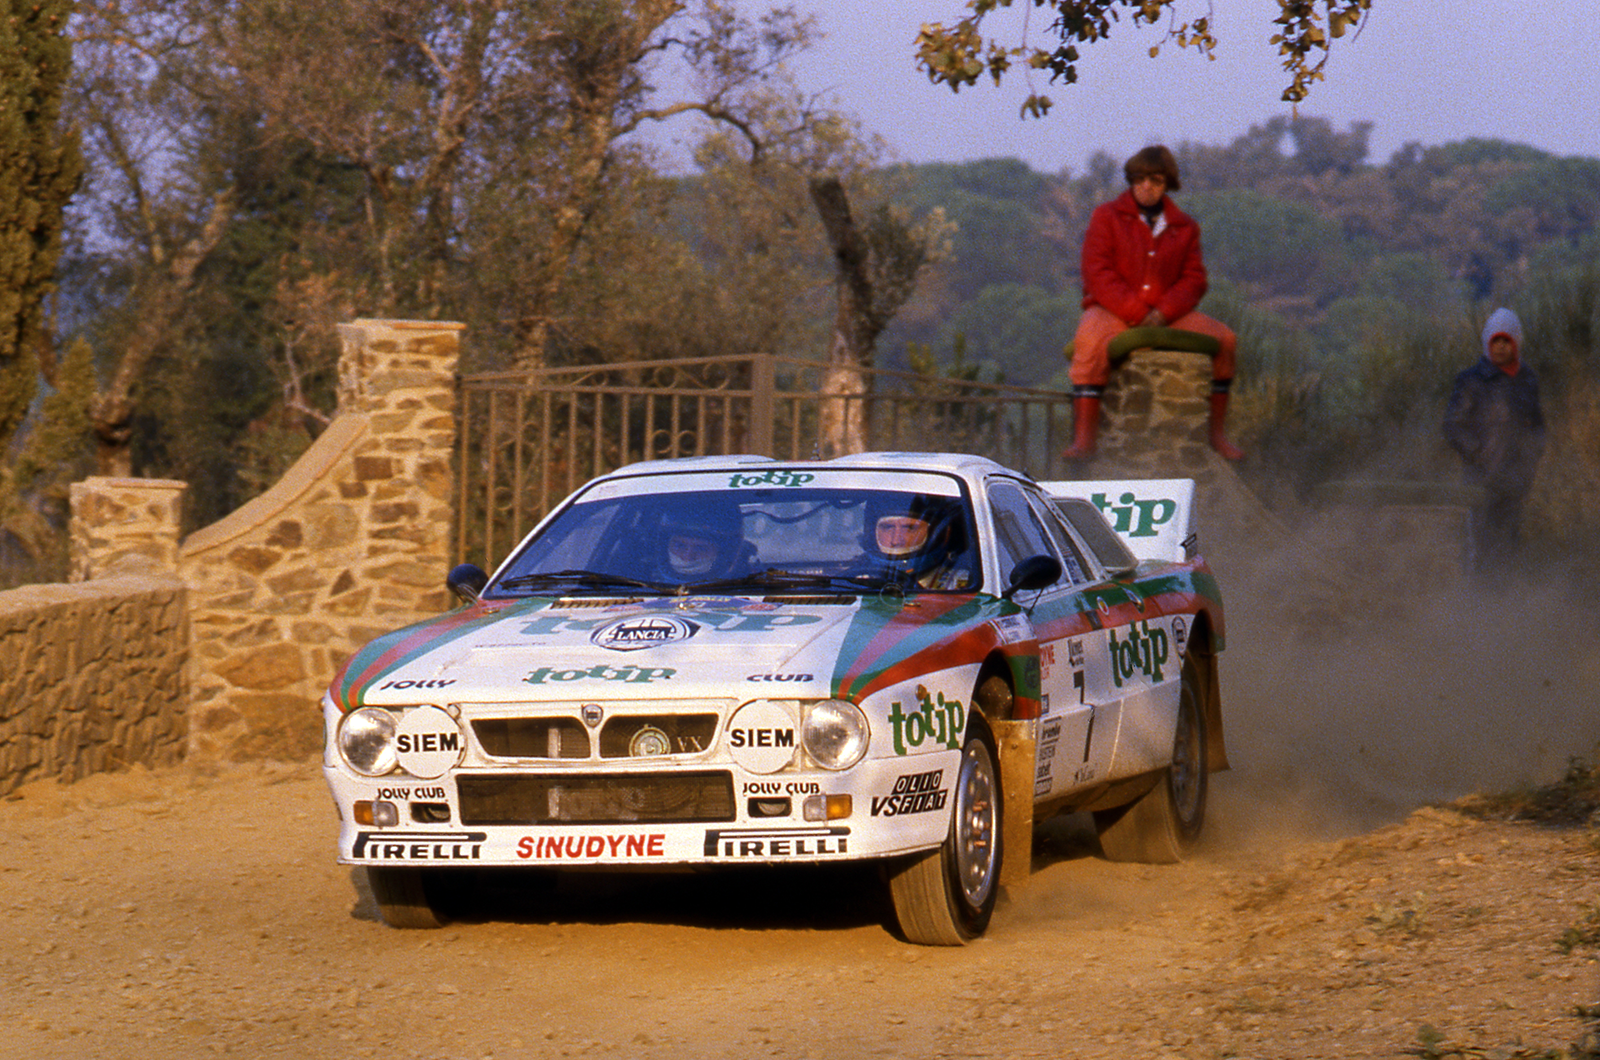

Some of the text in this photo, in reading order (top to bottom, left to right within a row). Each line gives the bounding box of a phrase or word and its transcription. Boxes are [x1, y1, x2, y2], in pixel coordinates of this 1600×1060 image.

[728, 470, 815, 488] totip
[616, 630, 667, 641] LANCIA
[1109, 619, 1169, 689] totip
[380, 673, 815, 691] JOLLY CLUB
[525, 665, 677, 685] totip
[887, 690, 965, 756] totip
[397, 732, 459, 753] SIEM
[730, 728, 795, 748] SIEM
[742, 782, 821, 797] JOLLY CLUB
[892, 769, 944, 795] OLIO
[376, 787, 445, 801] JOLLY CLUB
[352, 831, 488, 860] PIRELLI
[515, 834, 666, 859] SINUDYNE
[703, 826, 852, 858] PIRELLI
